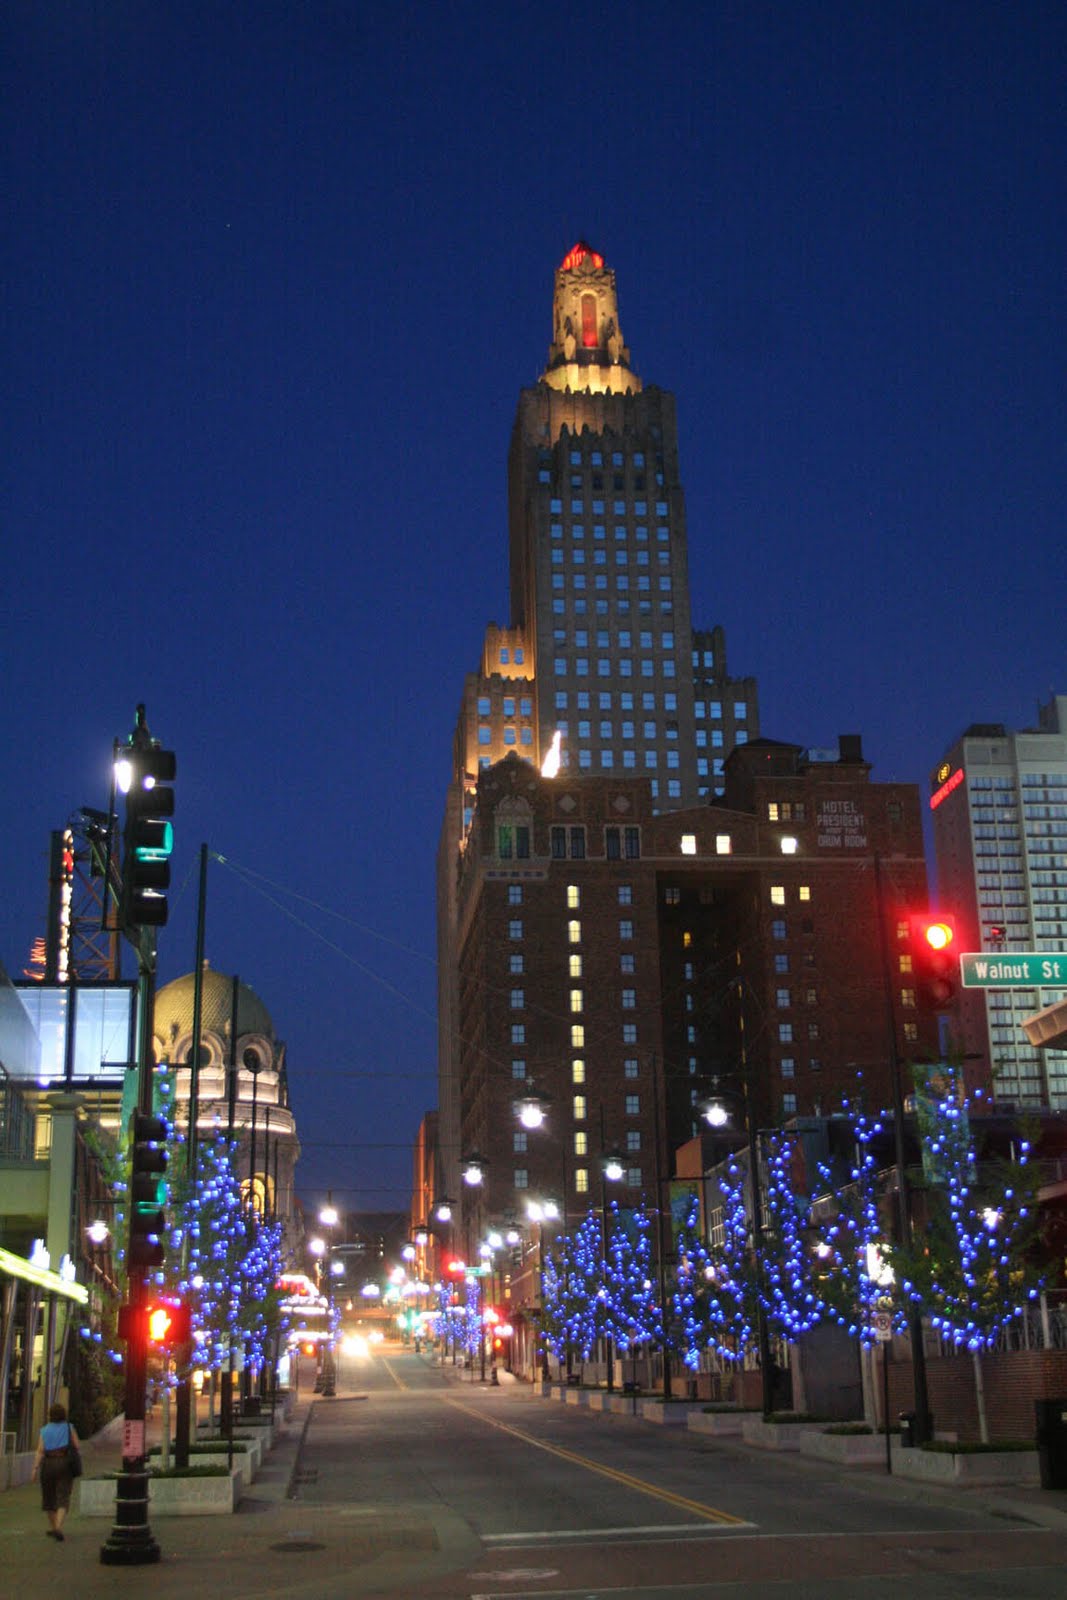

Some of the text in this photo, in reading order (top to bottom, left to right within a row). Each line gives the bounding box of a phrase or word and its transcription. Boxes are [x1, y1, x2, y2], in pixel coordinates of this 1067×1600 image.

[822, 800, 858, 813] HOTEL
[816, 813, 864, 826] PRESIDENT
[844, 835, 867, 848] ROOM
[975, 961, 1060, 979] Walnut St
